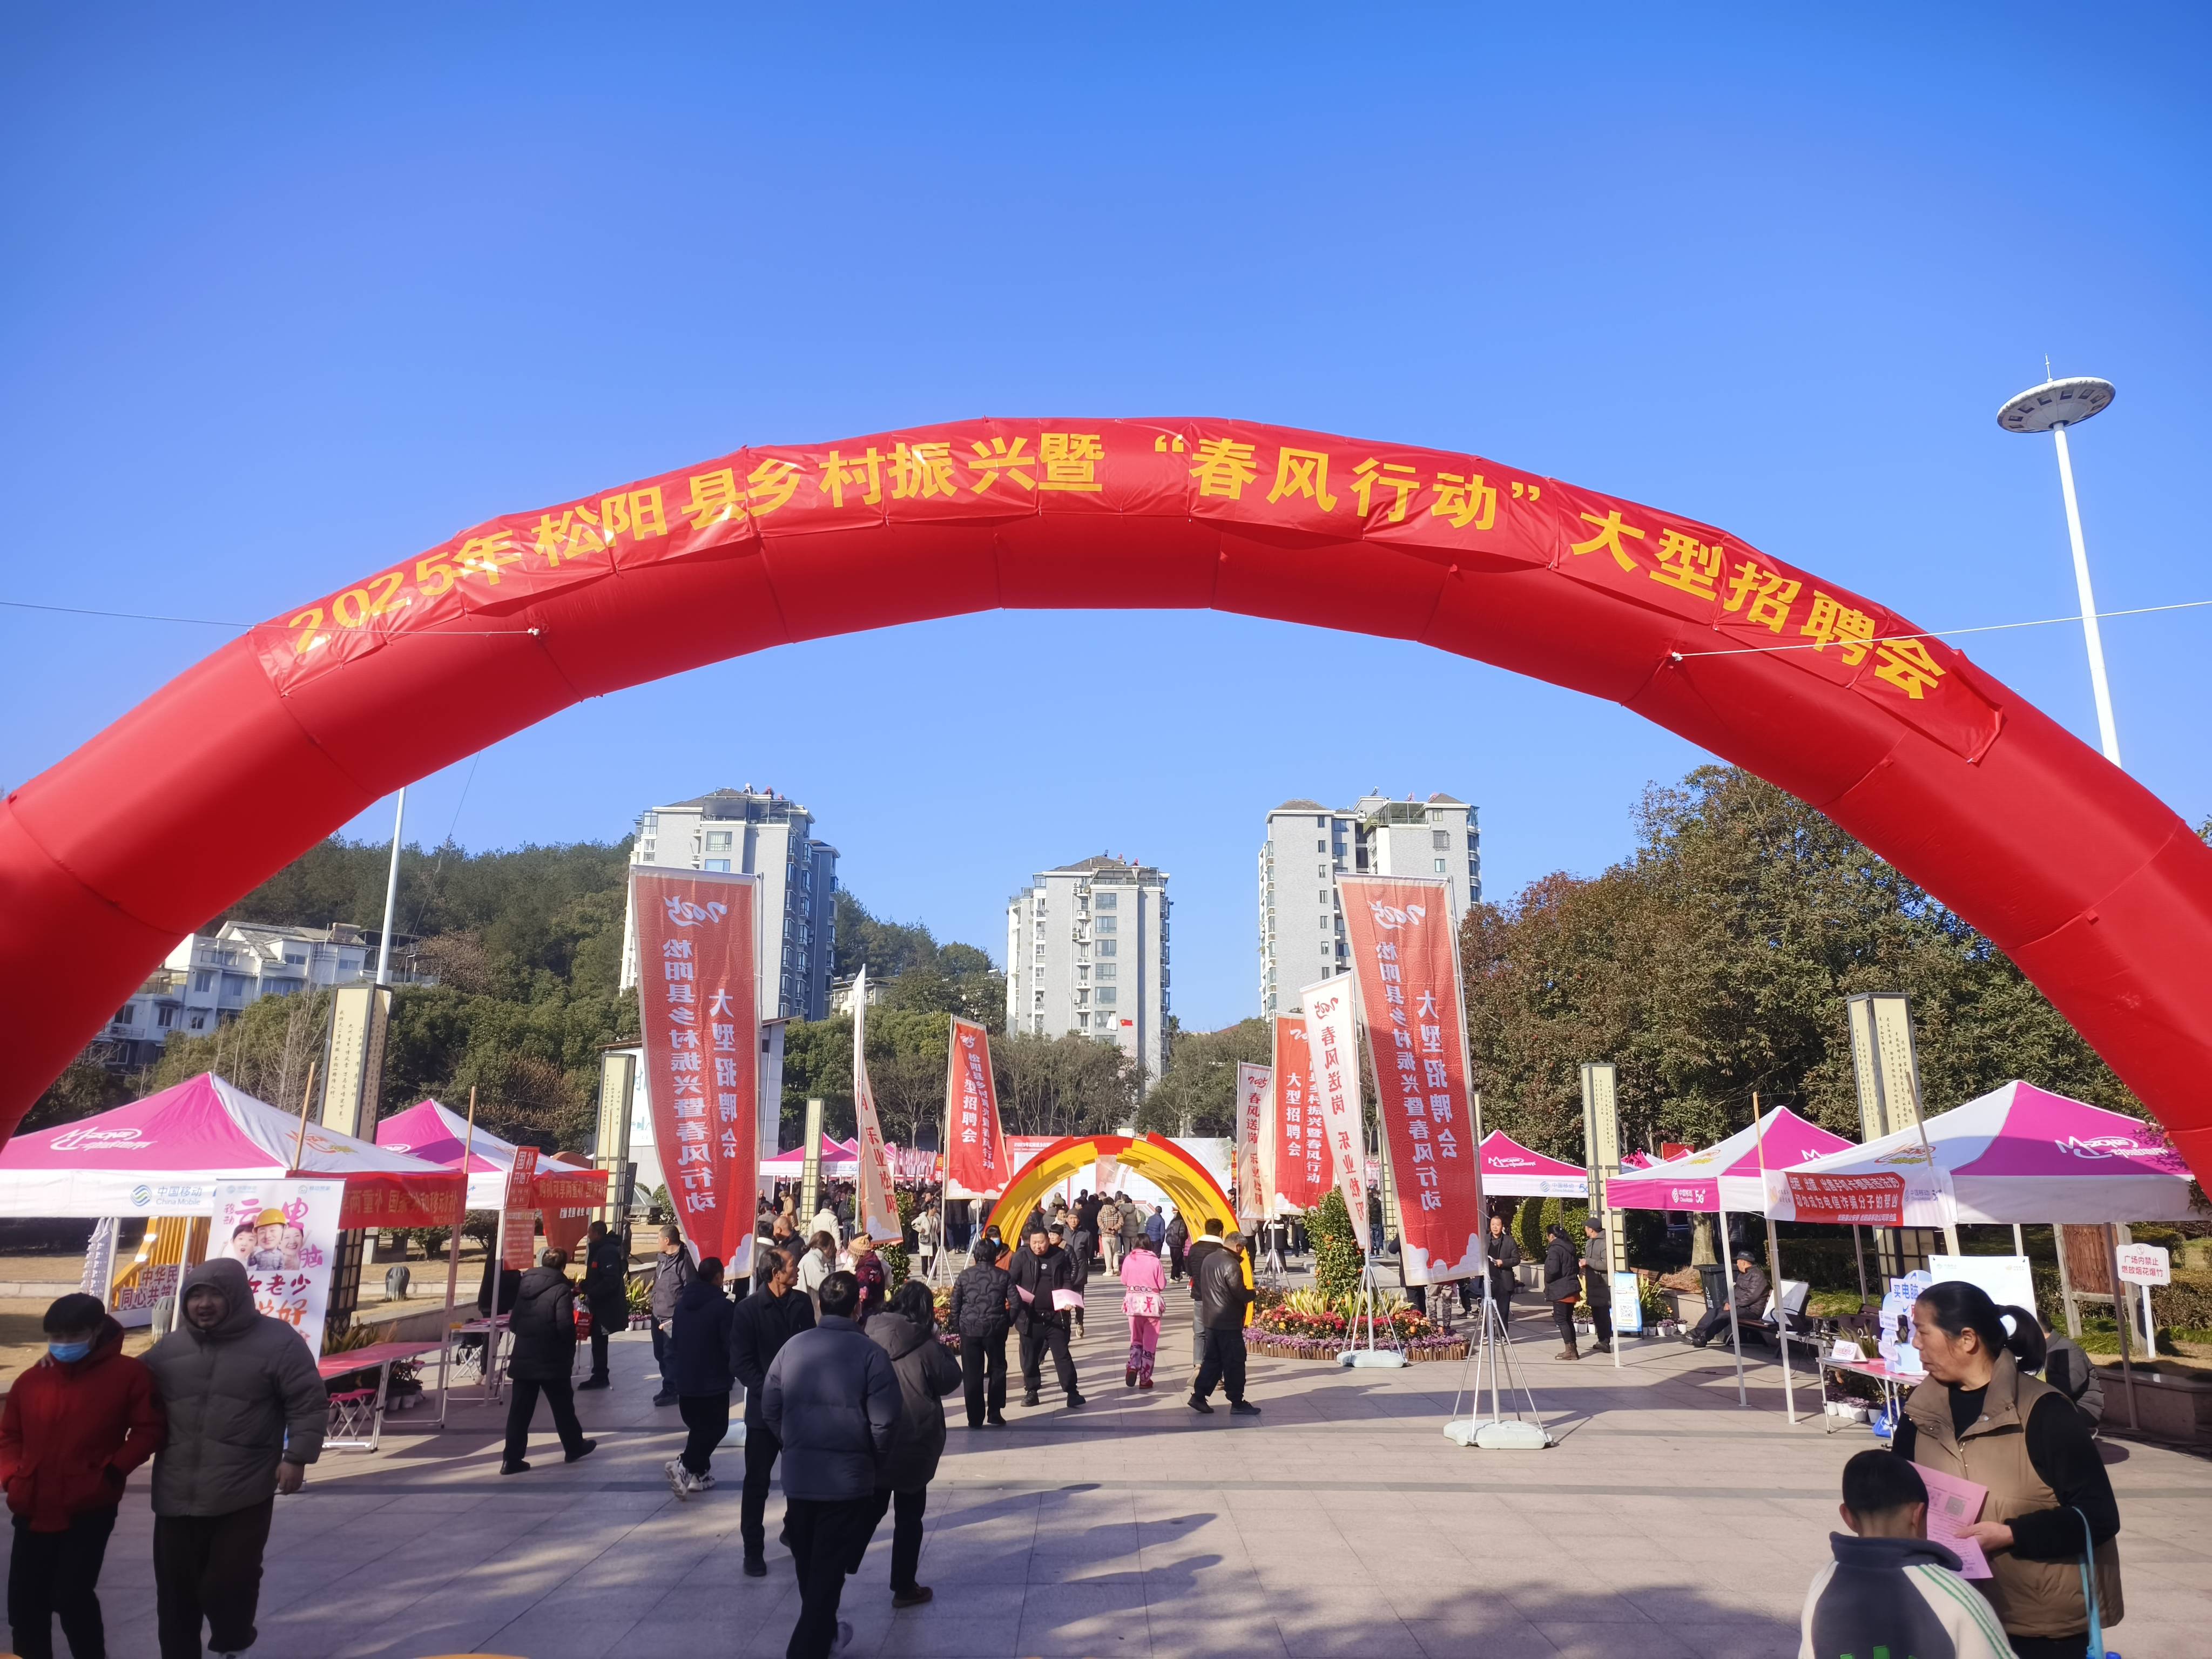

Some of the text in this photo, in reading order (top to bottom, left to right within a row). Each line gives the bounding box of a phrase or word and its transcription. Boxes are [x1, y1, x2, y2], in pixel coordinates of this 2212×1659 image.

[1246, 1092, 1260, 1144] 春风送岗
[1286, 1073, 1301, 1157] 大型招聘会
[516, 1151, 534, 1170] 国补
[513, 1172, 531, 1184] 开始了
[157, 1186, 202, 1197] 中国移动
[1795, 1193, 1899, 1210] 切勿成为电信诈骗分子的帮凶
[2125, 1255, 2159, 1266] 广场内禁止
[2121, 1265, 2163, 1277] 燃放烟花爆竹
